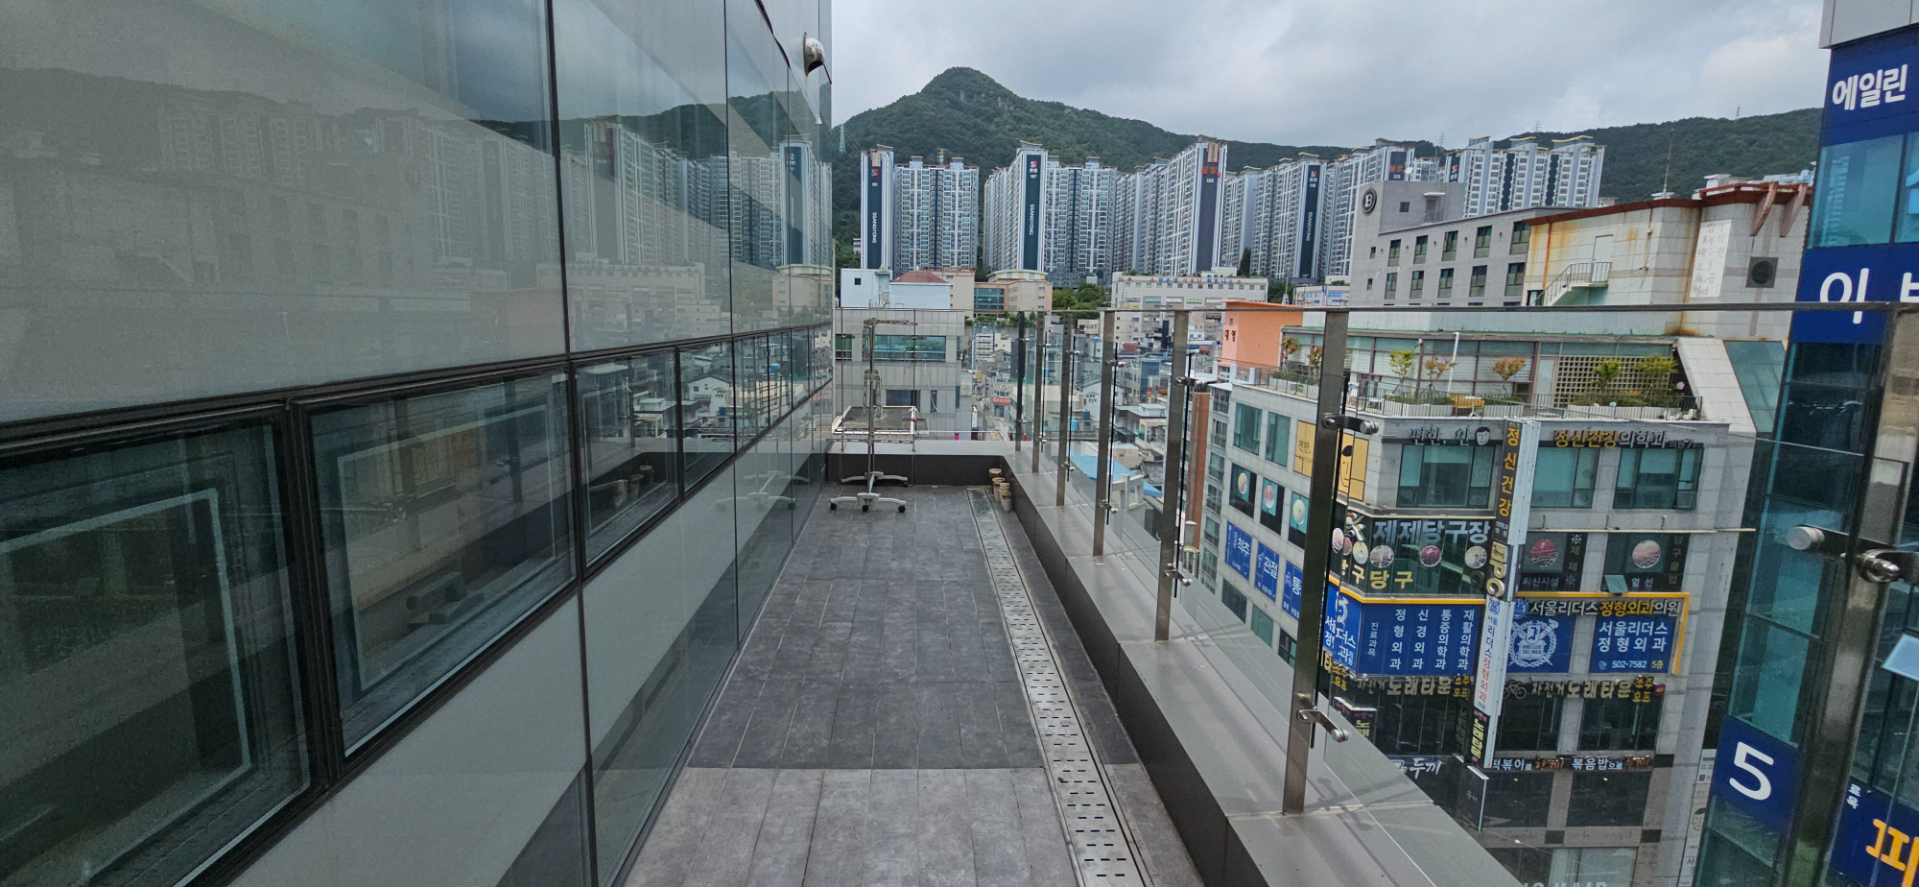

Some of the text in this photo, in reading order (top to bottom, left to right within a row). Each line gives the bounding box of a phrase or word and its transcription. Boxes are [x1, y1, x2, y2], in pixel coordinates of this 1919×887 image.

[1832, 64, 1908, 111] 에일린
[1554, 429, 1667, 450] 정신건강의학과
[1498, 427, 1520, 518] 정신건강
[1373, 519, 1491, 546] 제제당구장
[1369, 570, 1414, 590] 당구
[1530, 600, 1682, 617] 서울리더스 정형외과의원
[1389, 608, 1406, 671] 정형외과
[1411, 608, 1429, 671] 신경외과
[1434, 608, 1452, 671] 통증의학과
[1456, 608, 1475, 671] 재활의학과
[1599, 621, 1669, 637] 서울리더스
[1597, 637, 1667, 653] 정형외과
[1611, 660, 1664, 670] 502-7582 5층
[1386, 675, 1451, 696] 노래타운
[1477, 656, 1492, 704] 정형외과
[1531, 679, 1632, 700] 자전거 노래타운
[1409, 757, 1442, 780] 두끼
[1572, 757, 1624, 771] 볶음밥으로
[1729, 741, 1775, 801] 5
